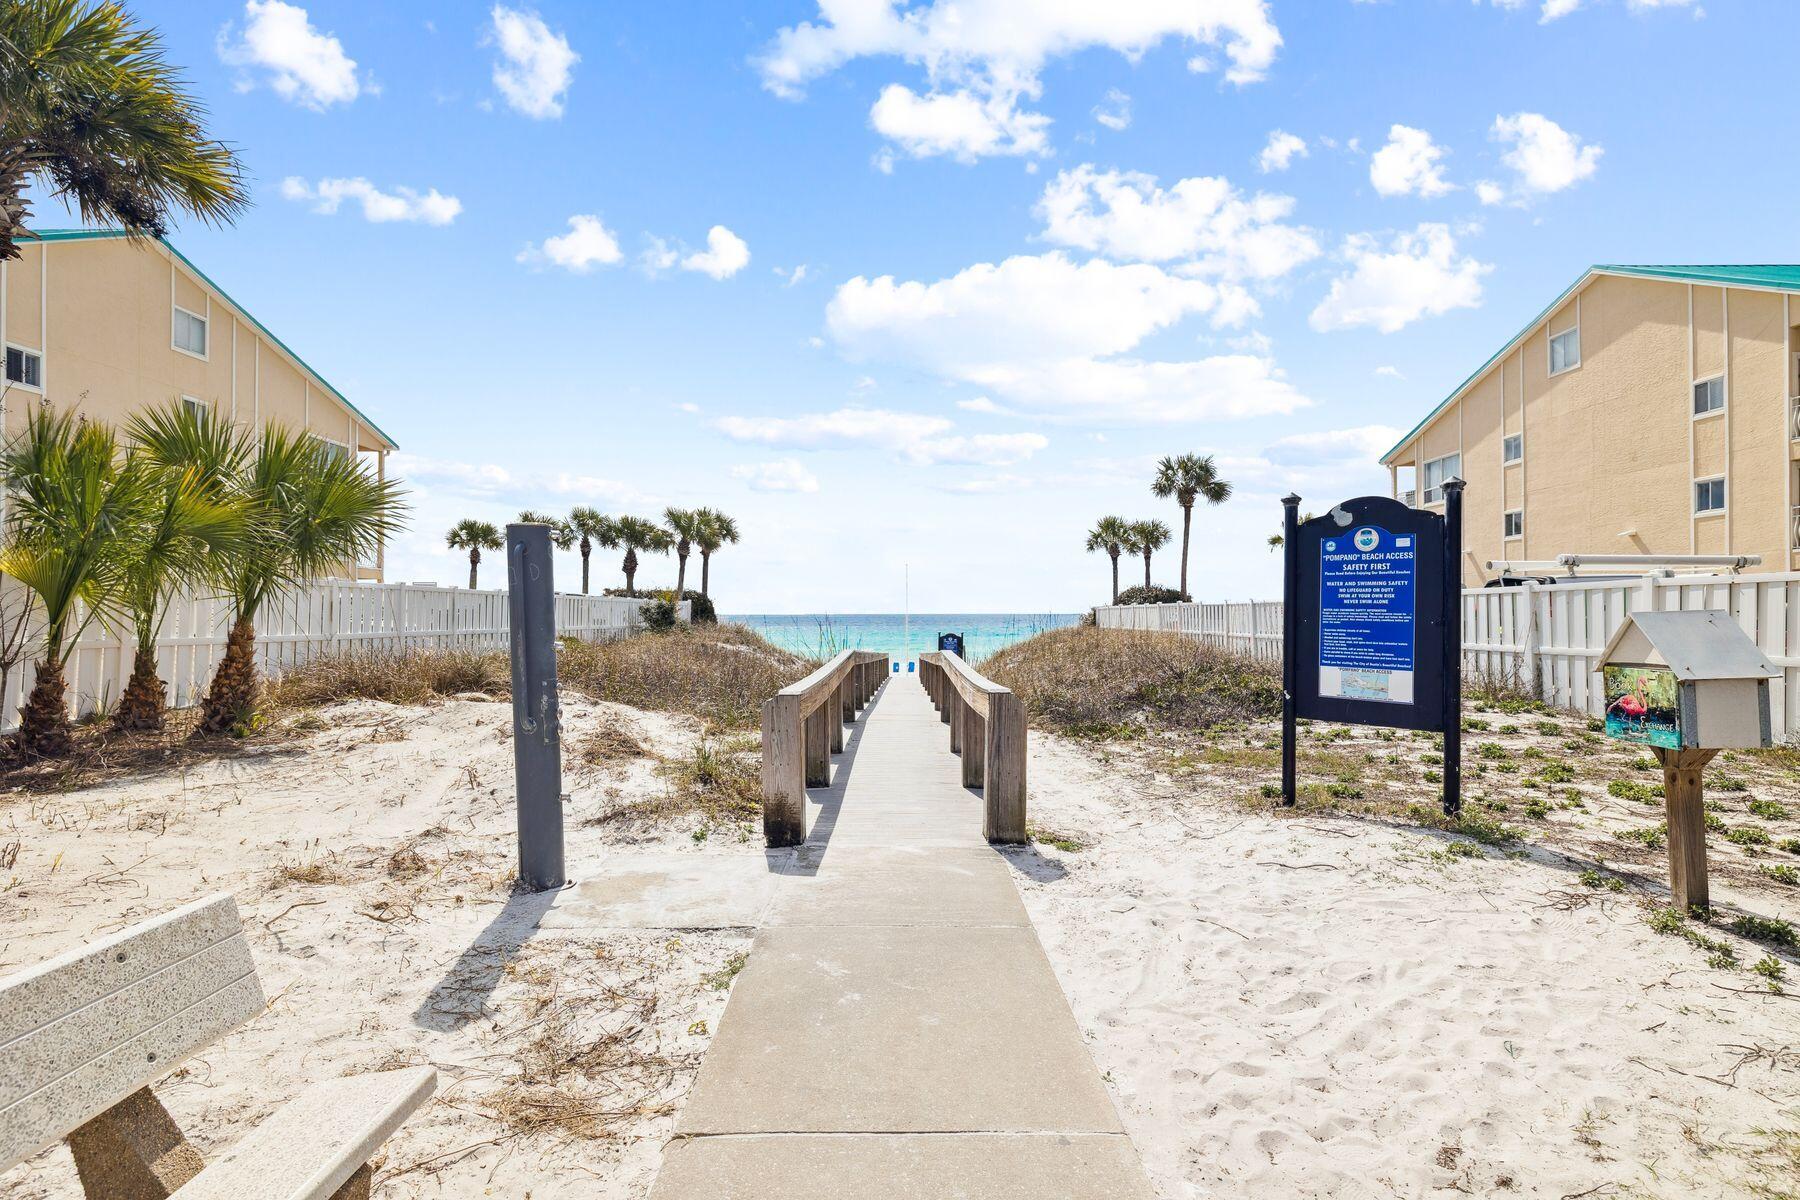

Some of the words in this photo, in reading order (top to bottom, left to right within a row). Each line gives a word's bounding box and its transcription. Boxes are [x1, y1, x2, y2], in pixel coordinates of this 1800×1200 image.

[1323, 553, 1360, 561] "POMPANO"
[1362, 552, 1384, 560] BEACH
[1385, 552, 1414, 560] ACCESS
[1342, 563, 1368, 571] SAFETY
